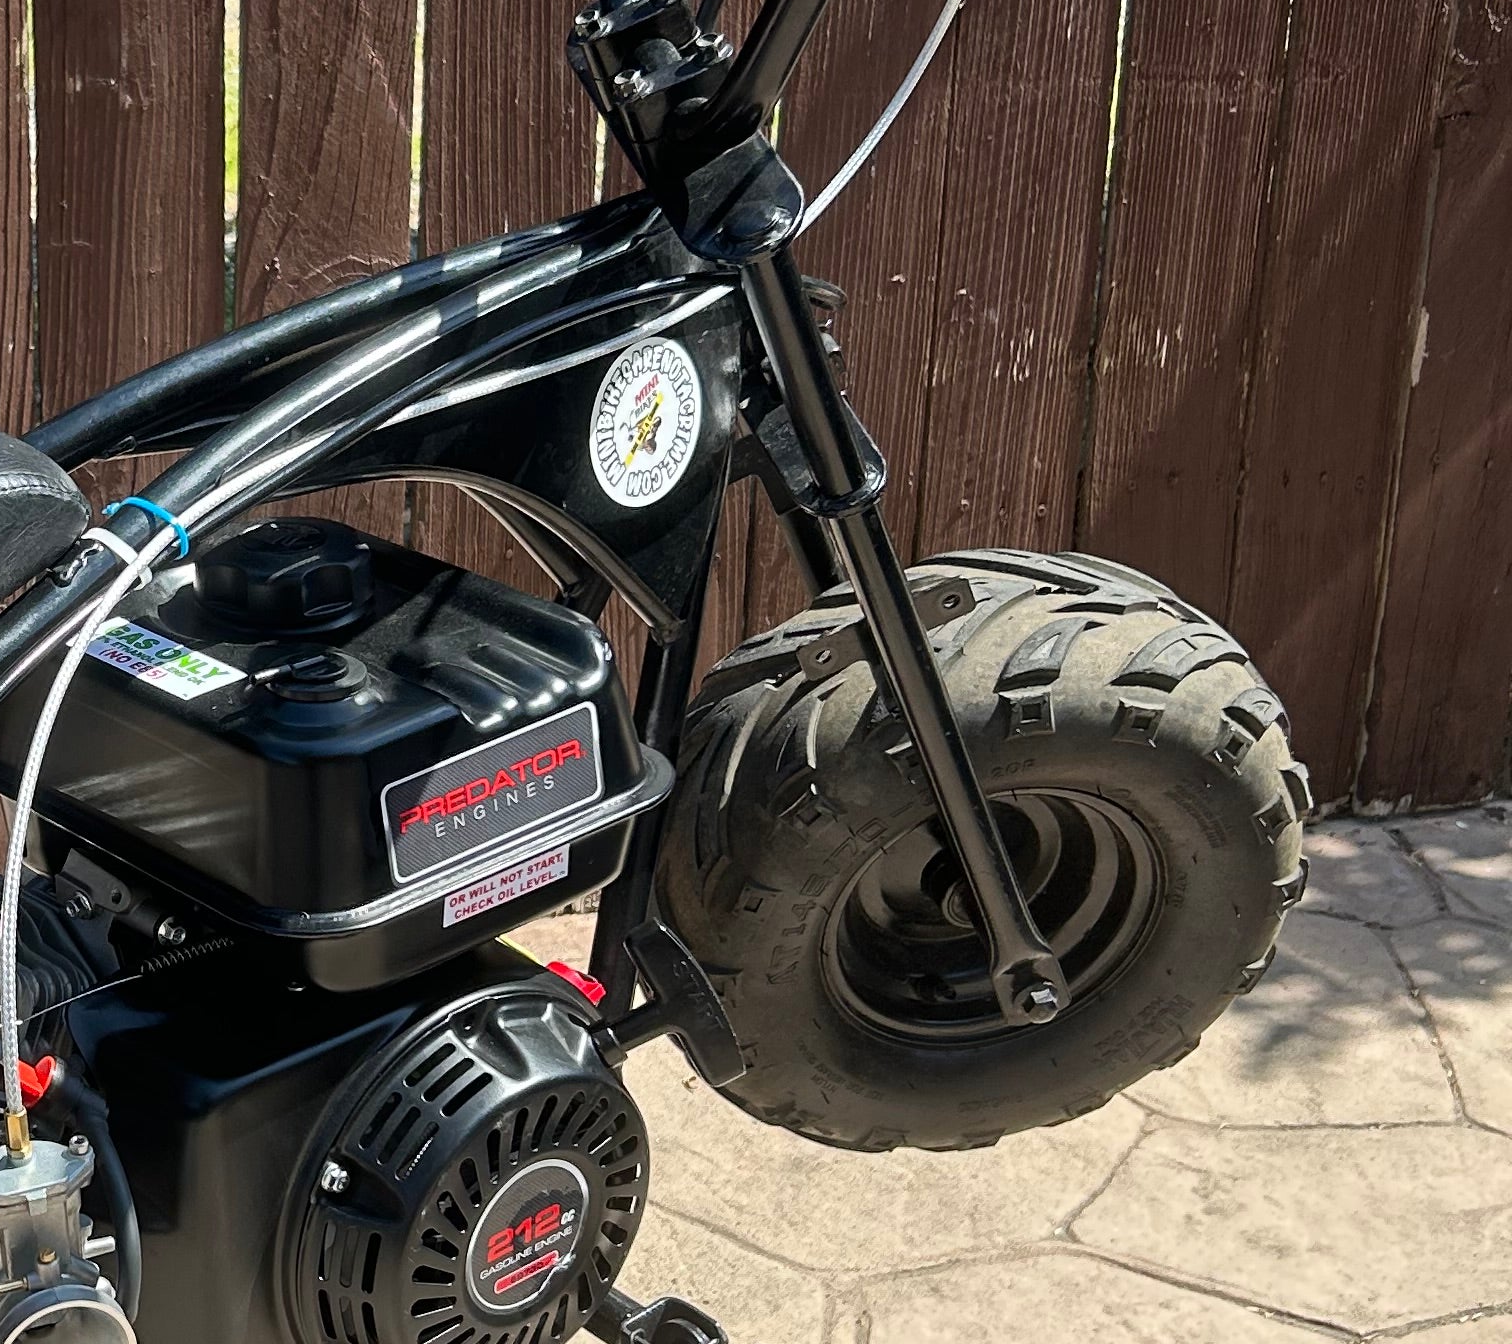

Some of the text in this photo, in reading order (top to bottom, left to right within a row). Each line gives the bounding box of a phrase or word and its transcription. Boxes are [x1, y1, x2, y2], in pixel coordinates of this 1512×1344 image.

[634, 373, 660, 406] MINI
[98, 647, 133, 667] (NO
[104, 624, 230, 678] GAS ONLY
[399, 738, 584, 835] PREDATOR
[434, 775, 555, 838] ENGINES
[449, 853, 564, 908] OR WILL NOT START,
[454, 897, 494, 920] CHECK
[497, 886, 516, 902] OIL
[479, 1246, 533, 1280] GASOLINE
[534, 1225, 574, 1252] ENGINE
[487, 1202, 561, 1263] 212
